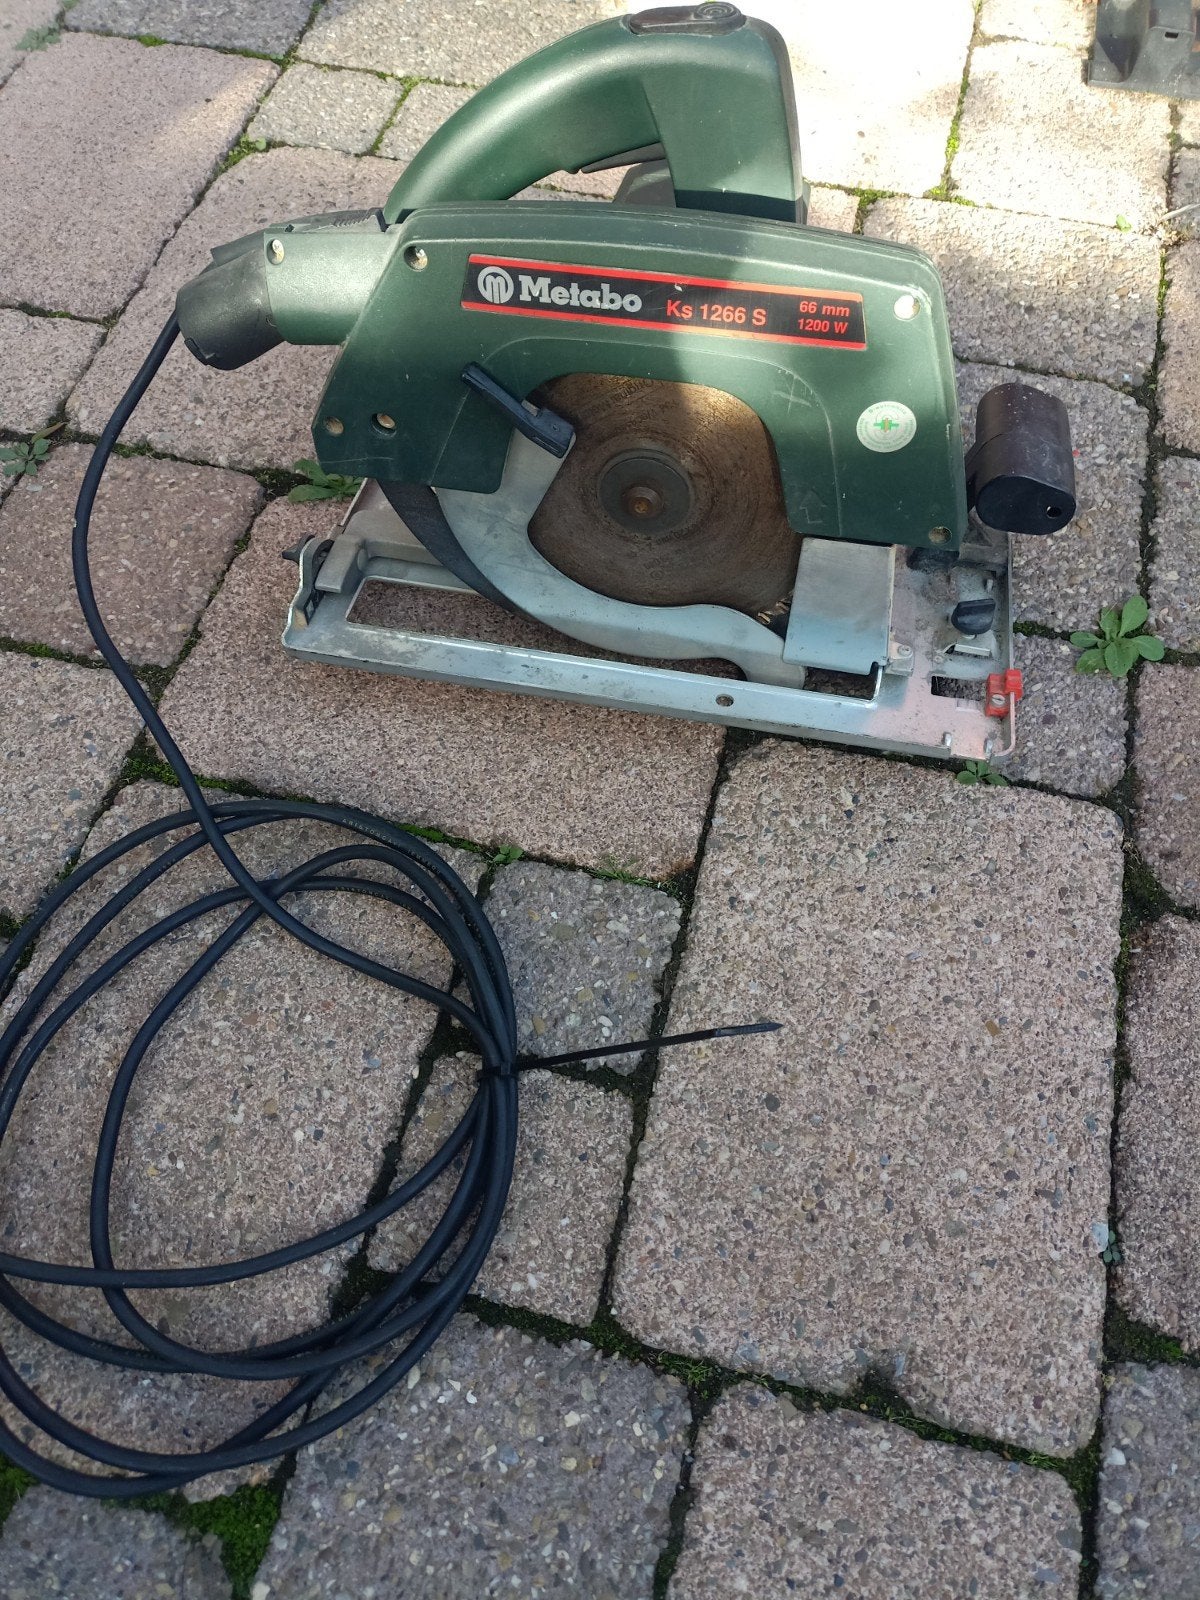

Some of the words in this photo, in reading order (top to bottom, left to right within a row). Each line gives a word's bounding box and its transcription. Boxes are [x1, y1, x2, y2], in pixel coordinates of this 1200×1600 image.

[518, 274, 643, 313] Metabo
[666, 299, 693, 320] Ks
[700, 303, 747, 324] 1266
[752, 308, 767, 326] S
[799, 300, 817, 314] 66
[821, 304, 850, 317] mm
[798, 318, 830, 333] 1200
[834, 321, 849, 335] W
